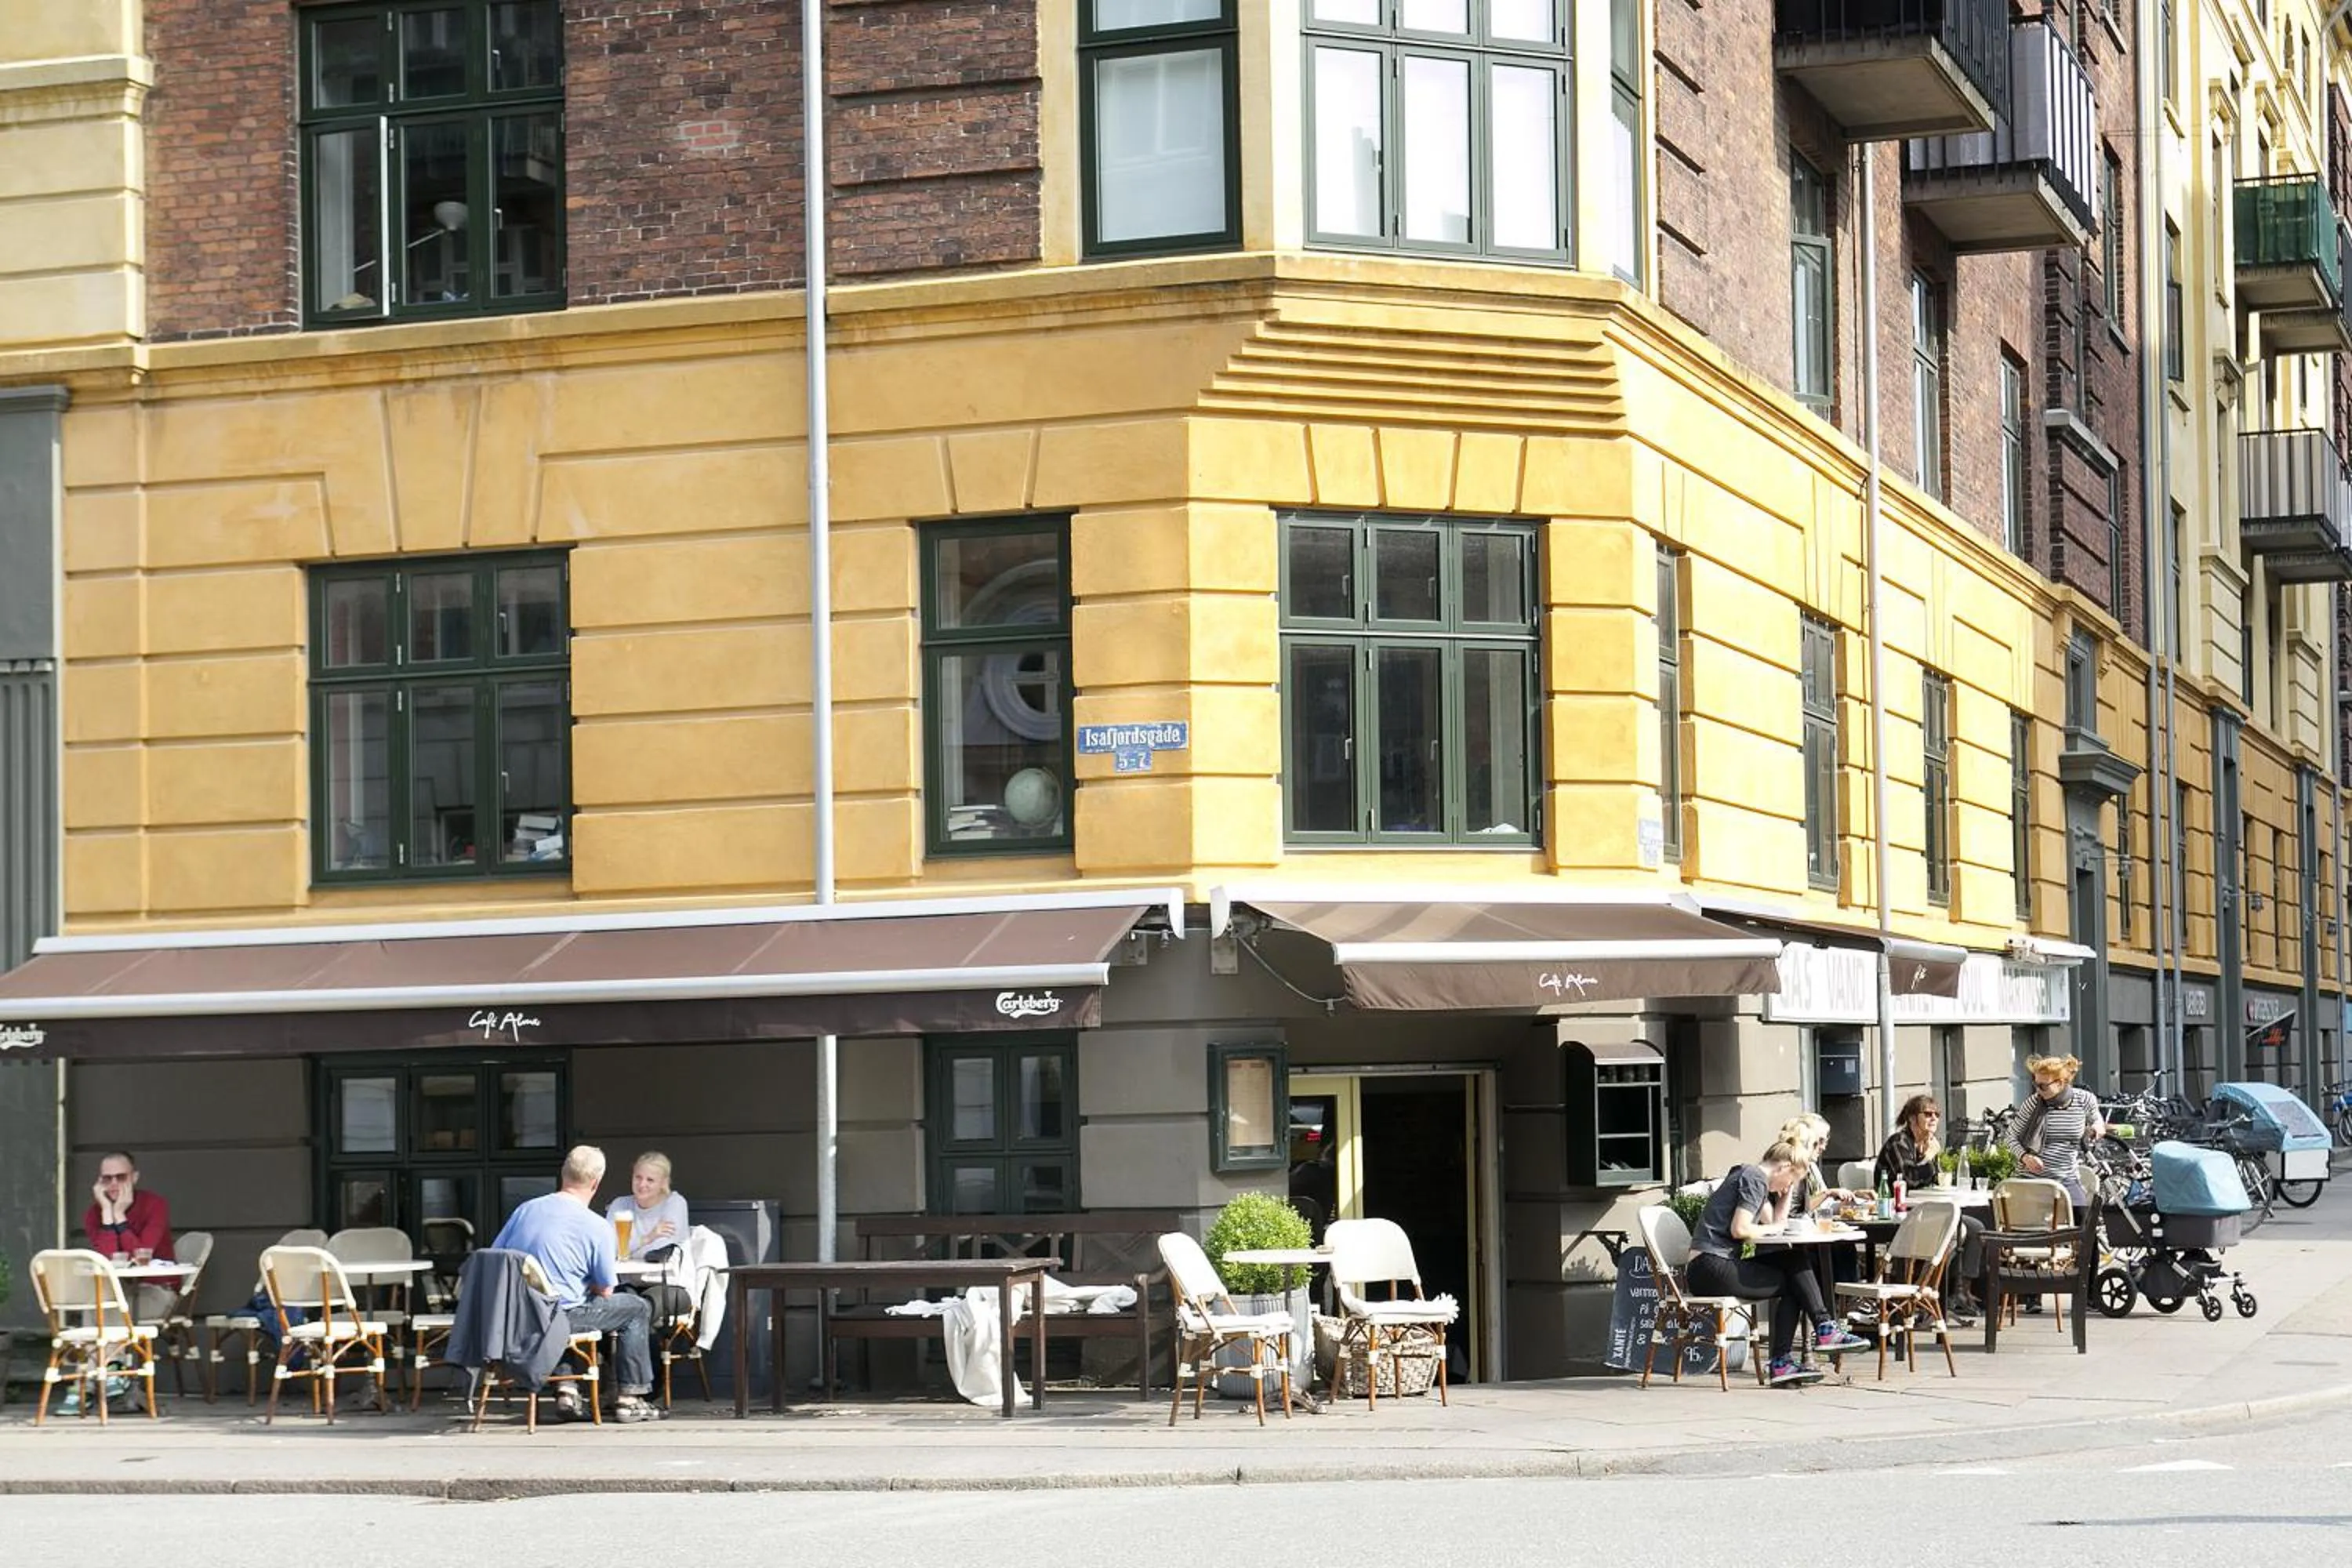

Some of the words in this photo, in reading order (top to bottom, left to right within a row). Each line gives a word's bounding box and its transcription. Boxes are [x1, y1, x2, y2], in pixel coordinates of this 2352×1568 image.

[1086, 725, 1180, 749] Isafjordsgade
[1826, 952, 1865, 1011] VAND
[996, 990, 1064, 1018] Carlsberg
[498, 1011, 542, 1042] Alma
